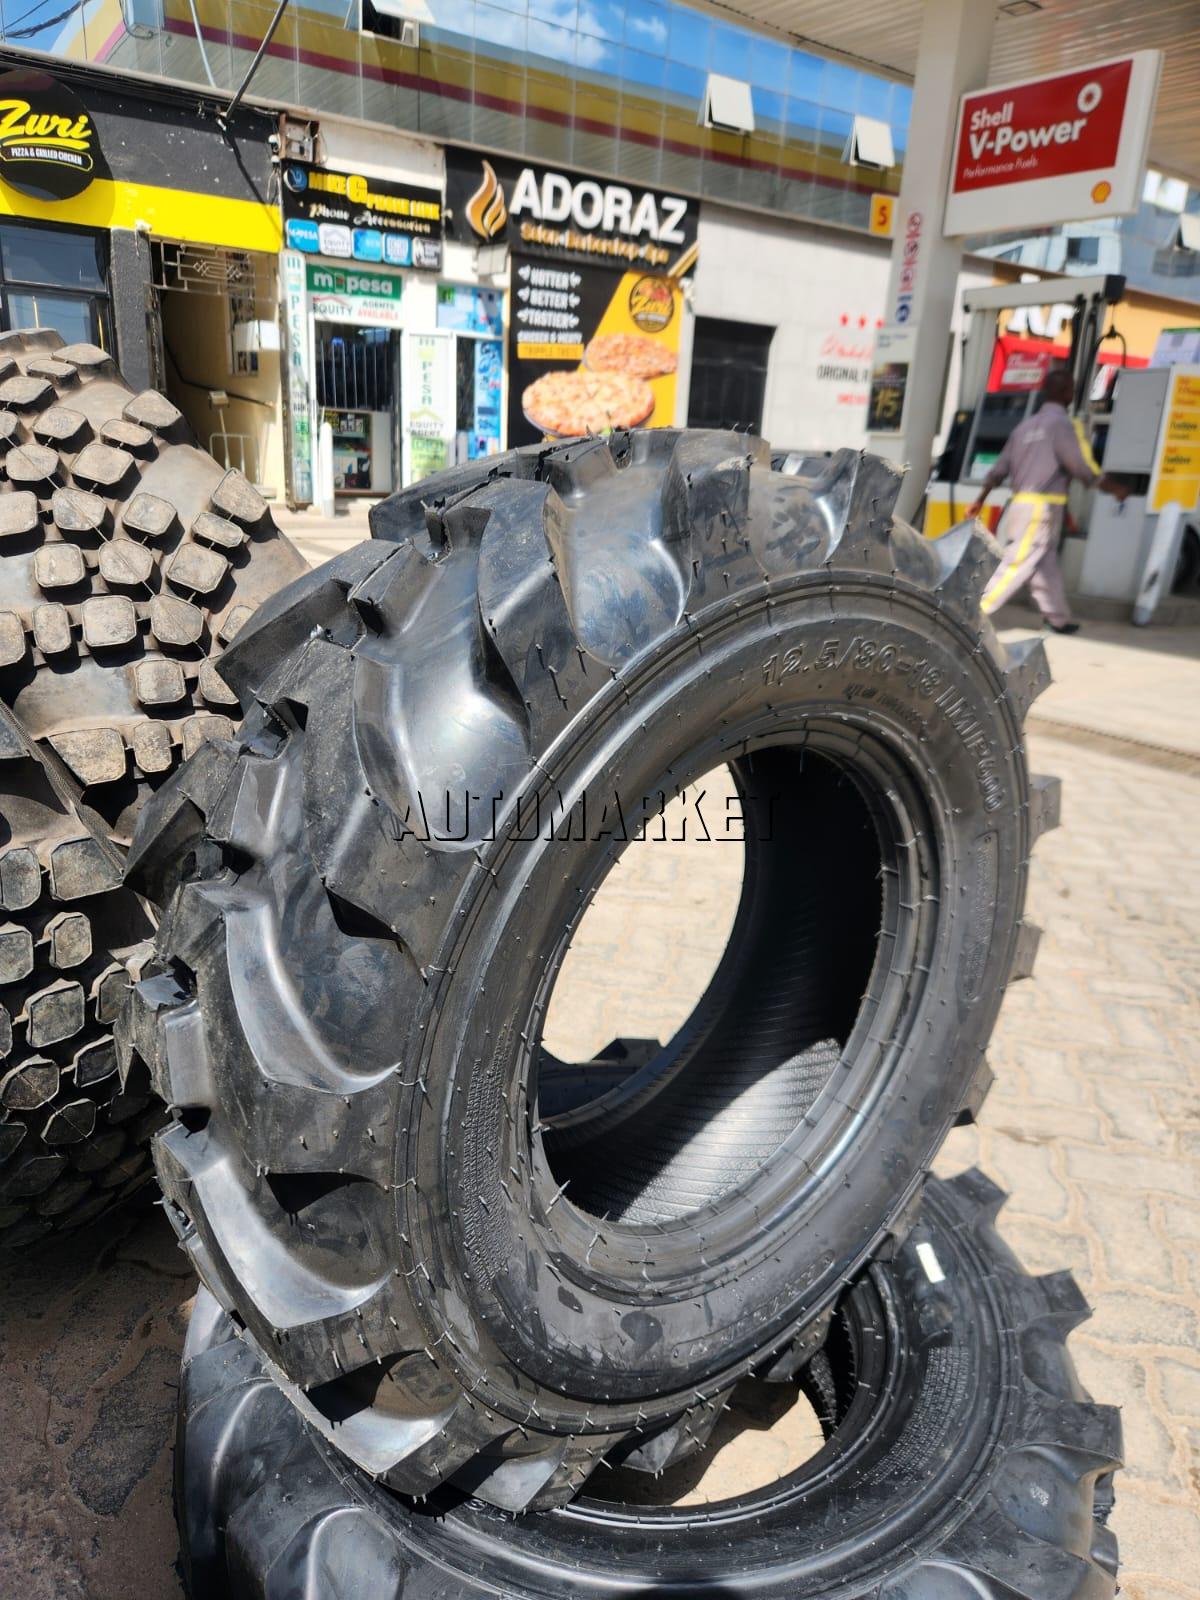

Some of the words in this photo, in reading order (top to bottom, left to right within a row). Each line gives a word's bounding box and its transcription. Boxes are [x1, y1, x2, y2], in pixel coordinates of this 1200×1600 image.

[0, 99, 92, 139] Zuri
[970, 102, 1014, 130] Shell
[969, 117, 1088, 160] V-Power
[11, 147, 29, 158] PIZZA
[29, 148, 35, 157] &
[36, 148, 57, 160] GRILLED
[59, 151, 82, 166] CHICKEN
[963, 160, 1014, 179] Performance
[1015, 156, 1039, 173] Fuels
[510, 168, 688, 244] ADORAZ
[878, 205, 888, 227] 5
[529, 289, 569, 309] BETTER
[313, 302, 353, 319] EQUITY
[528, 309, 569, 328] TASTIER
